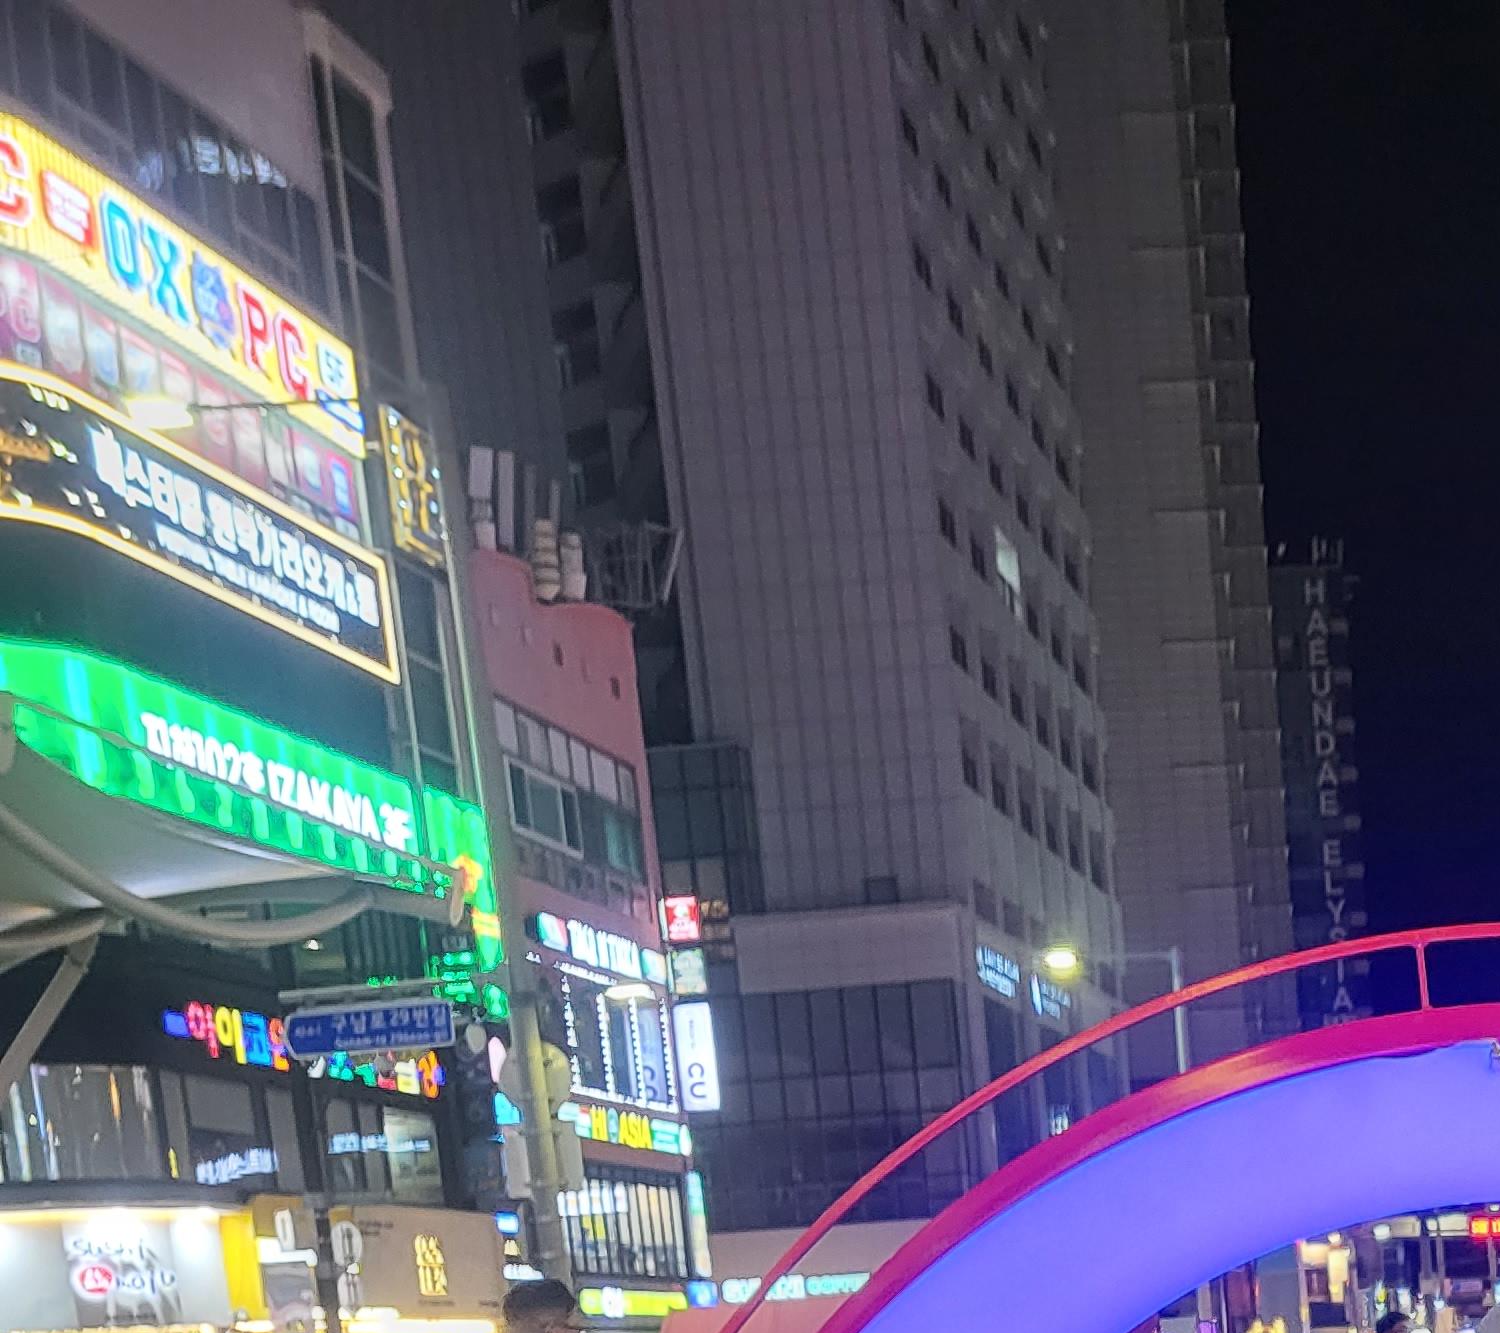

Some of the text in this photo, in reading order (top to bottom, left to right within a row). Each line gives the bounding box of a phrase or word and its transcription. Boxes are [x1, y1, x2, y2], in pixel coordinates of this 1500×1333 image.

[101, 194, 192, 326] OX
[236, 282, 314, 402] PC
[1305, 578, 1339, 817] HAEUNDAE
[618, 1110, 653, 1150] ASIA
[687, 1062, 707, 1099] CU
